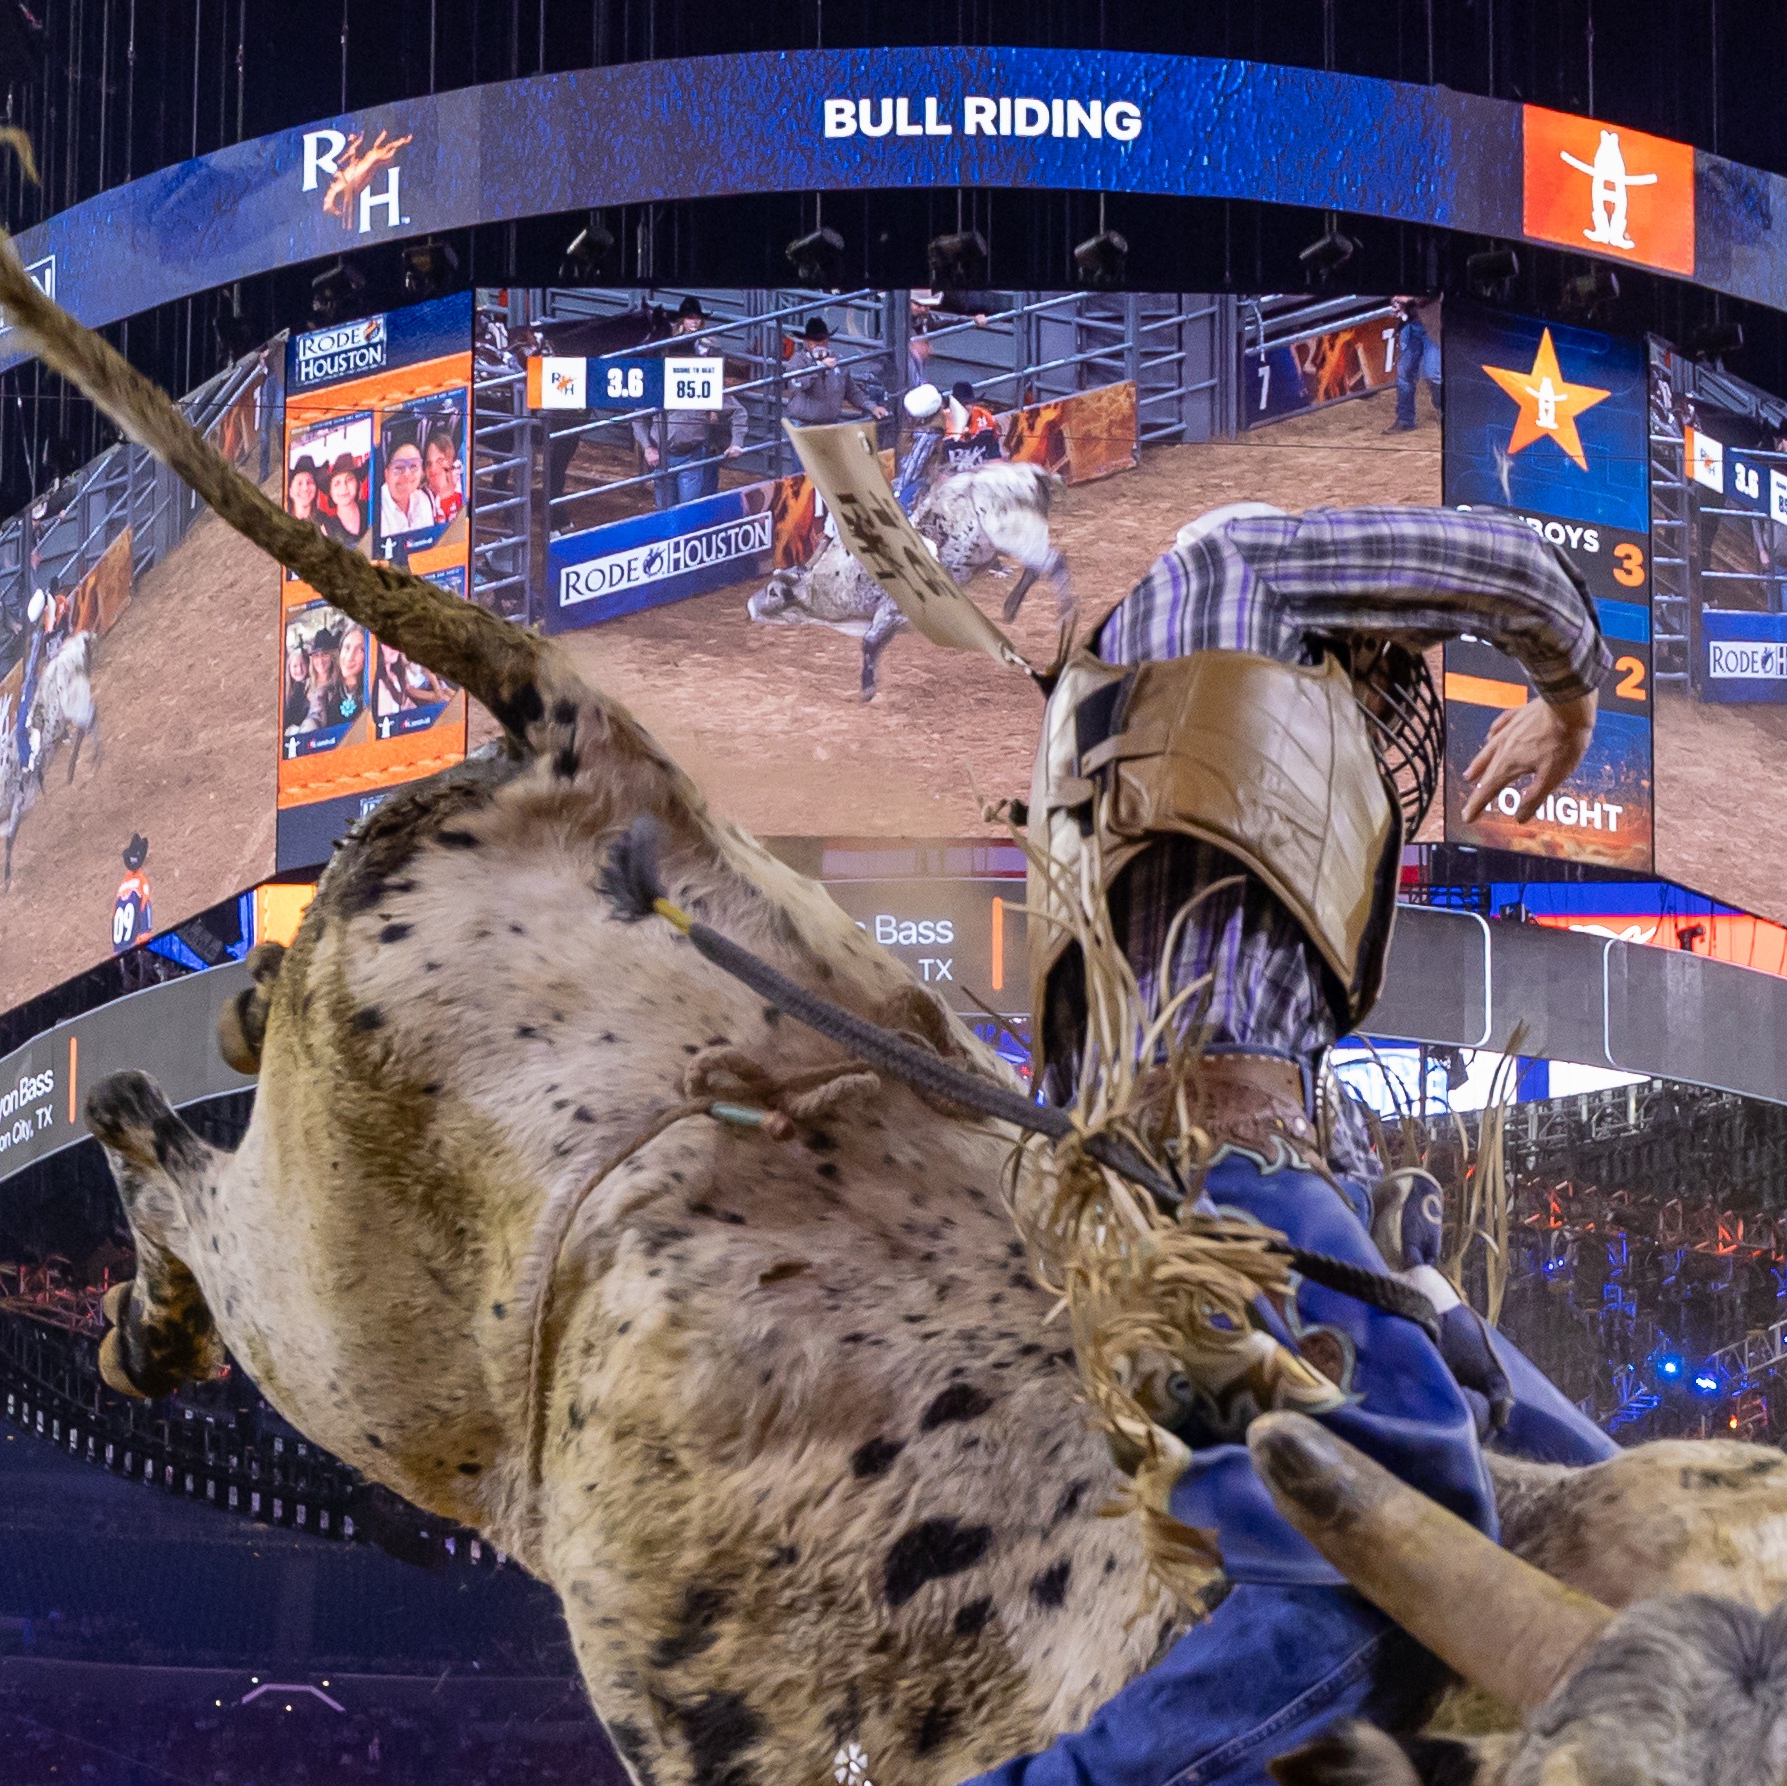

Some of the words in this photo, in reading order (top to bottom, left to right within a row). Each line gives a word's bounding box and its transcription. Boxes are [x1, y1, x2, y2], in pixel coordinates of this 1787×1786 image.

[824, 96, 952, 139] BULL
[964, 95, 1142, 141] RIDING
[302, 320, 380, 355] RODEO
[300, 345, 382, 381] HOUSTON
[607, 368, 644, 398] 3.6
[676, 380, 711, 399] 85.0
[565, 545, 664, 600] RODEO
[669, 518, 770, 574] HOUSTON
[1612, 543, 1645, 587] 3
[1714, 645, 1774, 675] RODEO
[1615, 656, 1647, 702] 2
[1478, 784, 1623, 832] OIGHT
[114, 902, 135, 944] 09
[875, 914, 954, 945] Bass
[917, 958, 954, 982] TX
[18, 1069, 55, 1103] Bass
[35, 1104, 54, 1127] TX
